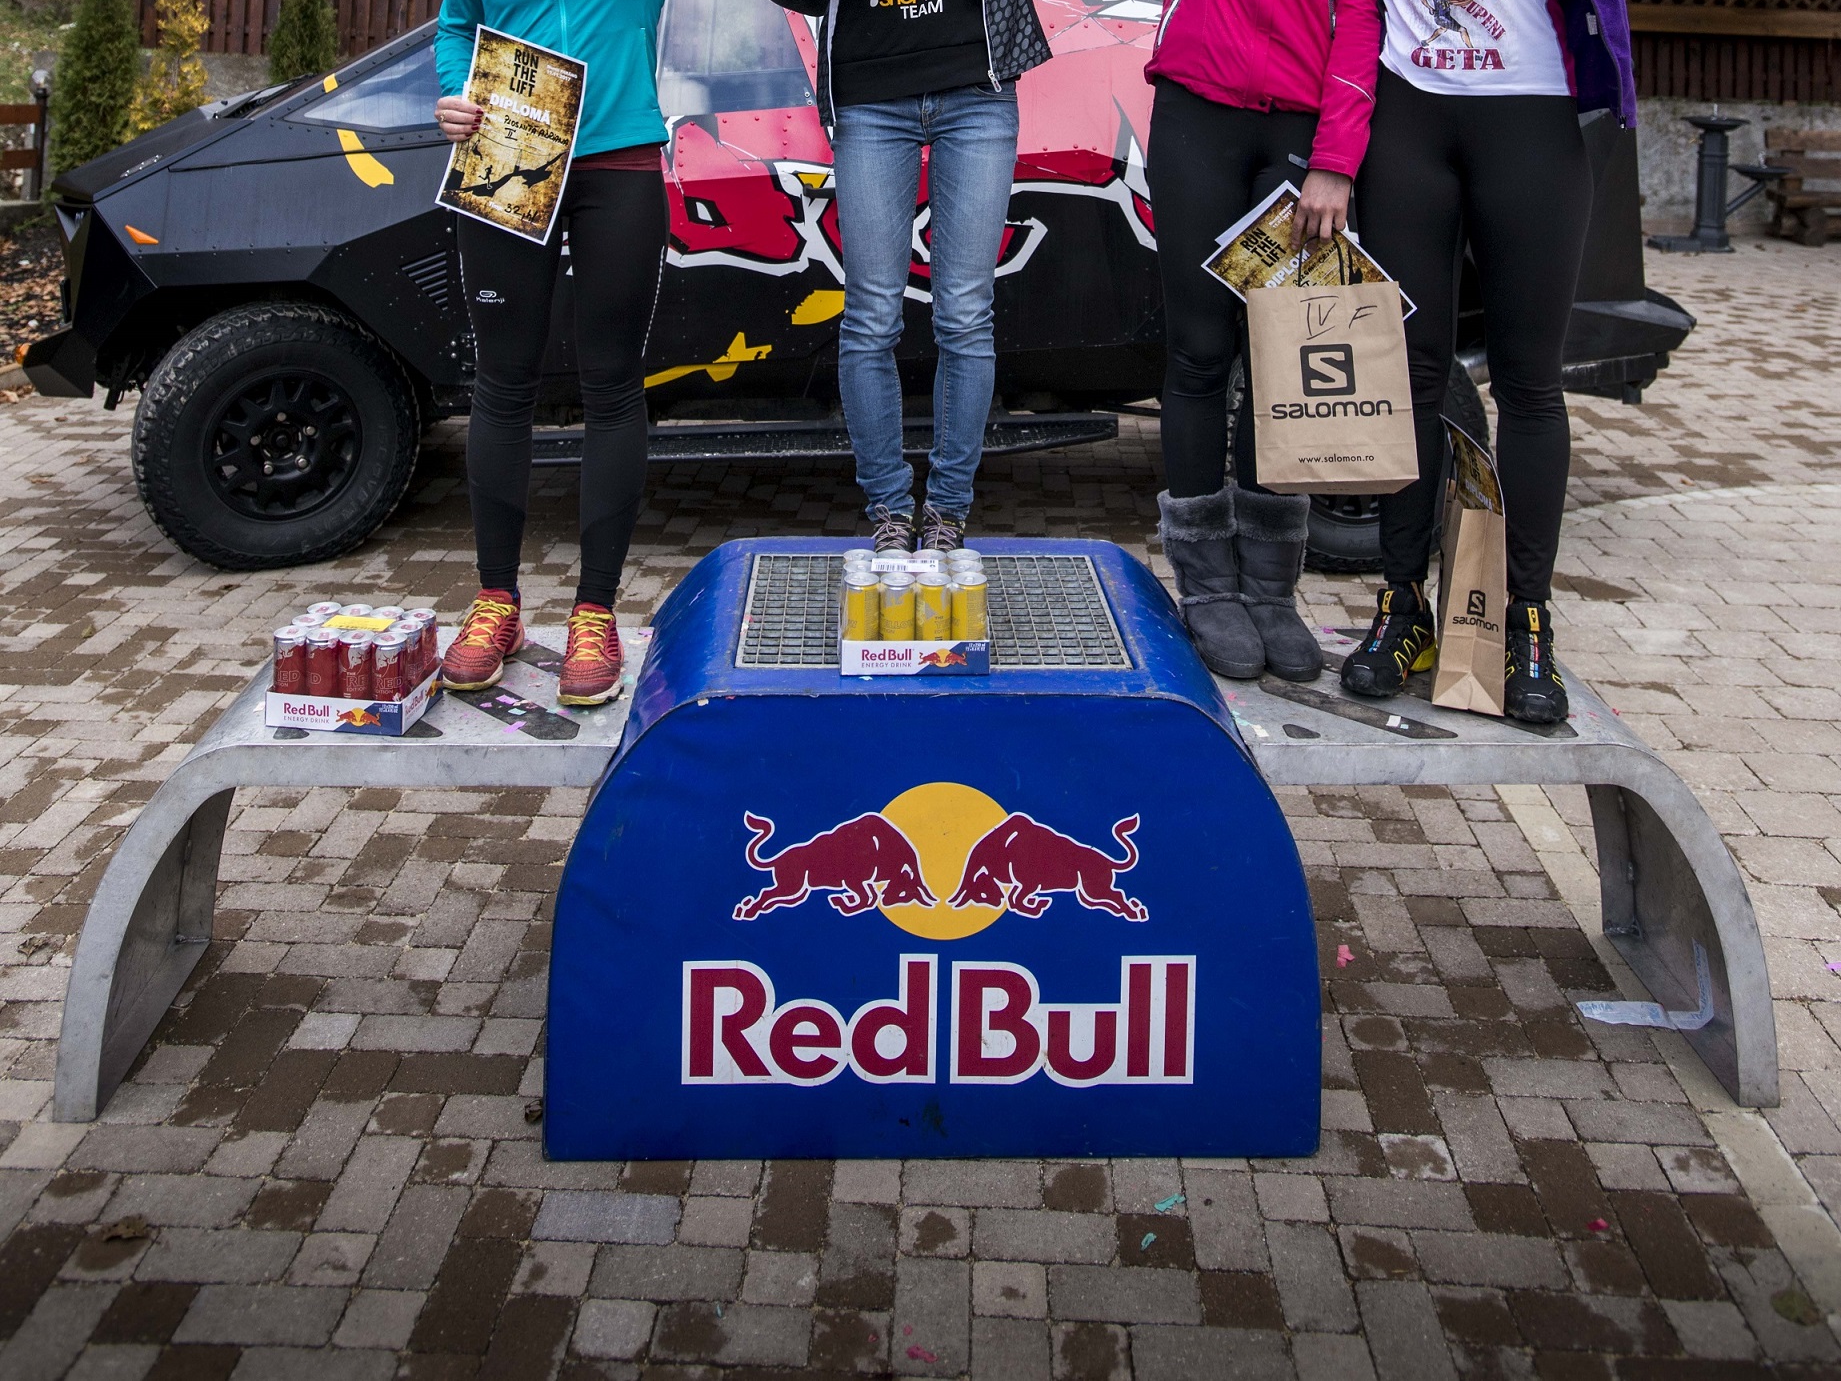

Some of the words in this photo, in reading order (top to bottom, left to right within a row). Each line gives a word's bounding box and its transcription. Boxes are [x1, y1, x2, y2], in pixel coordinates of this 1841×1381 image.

[900, 0, 944, 19] TEAM
[514, 49, 539, 69] RUN
[1410, 47, 1506, 70] GETA
[514, 63, 537, 83] THE
[510, 77, 535, 97] LIFT
[1240, 227, 1267, 251] RUN
[1250, 235, 1277, 258] THE
[1261, 243, 1286, 268] LIFT
[1265, 249, 1311, 288] DIPLOM
[1298, 453, 1374, 463] www.salomon.ro
[862, 649, 886, 661] Red
[888, 649, 912, 661] Bull
[284, 703, 306, 715] Red
[308, 705, 330, 717] Bull
[686, 957, 934, 1082] Red
[954, 959, 1192, 1083] Bull
